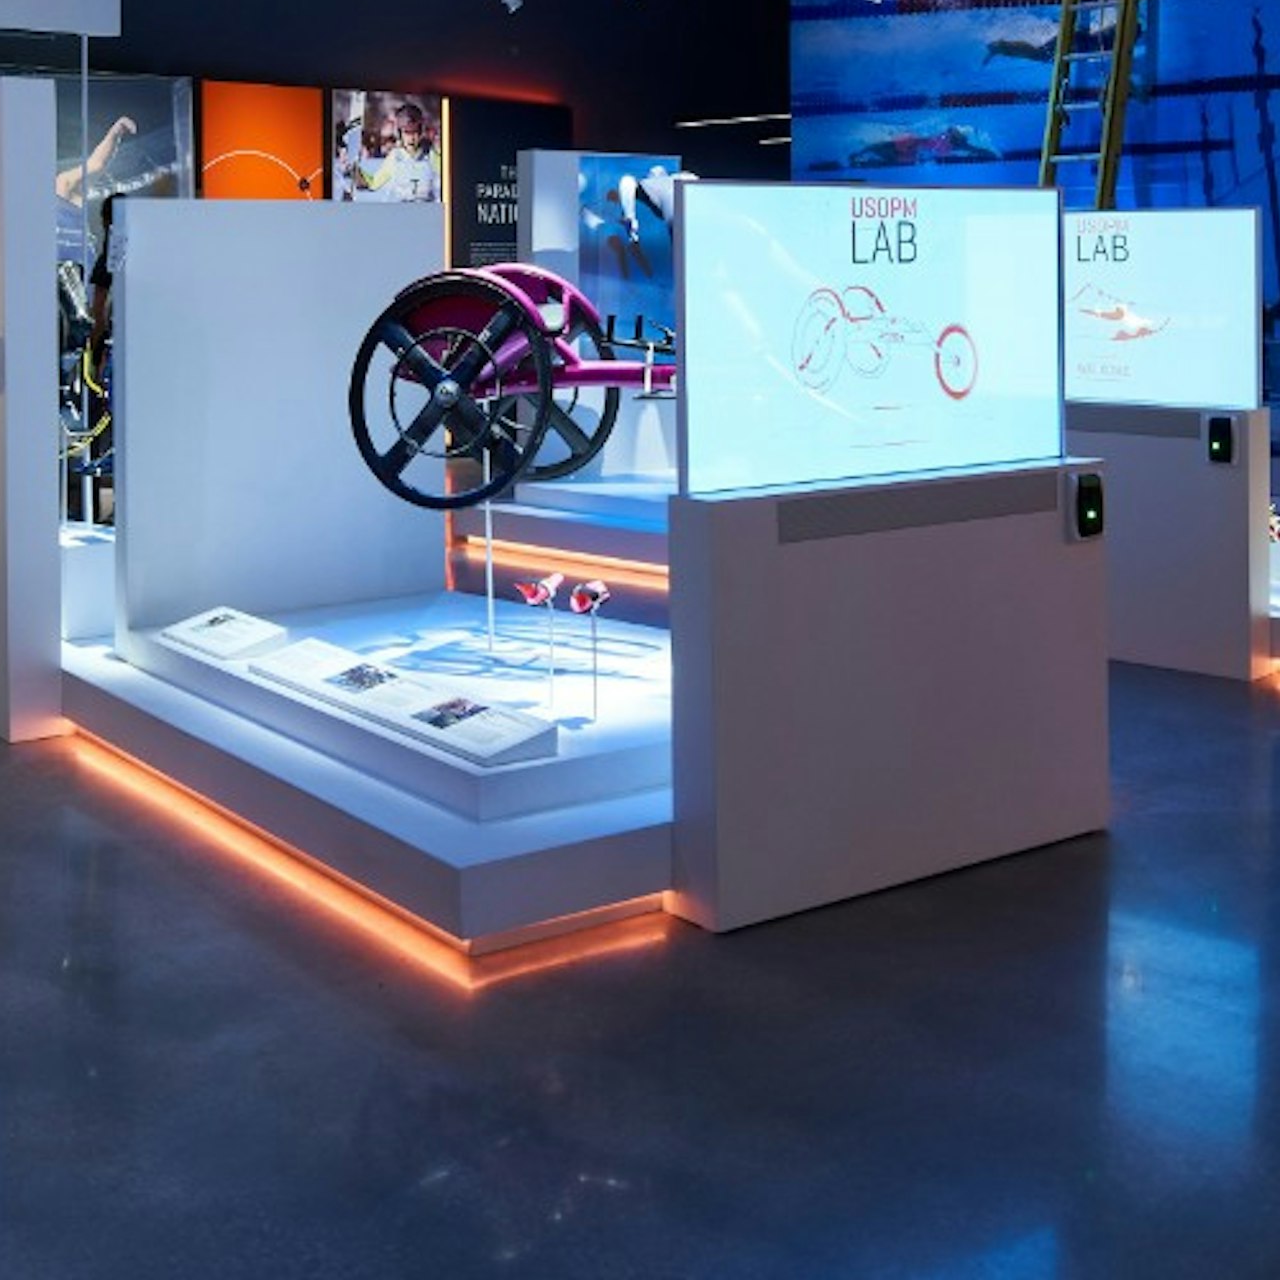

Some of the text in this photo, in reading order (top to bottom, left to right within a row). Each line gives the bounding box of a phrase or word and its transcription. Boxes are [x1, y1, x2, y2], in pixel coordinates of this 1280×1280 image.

[851, 196, 917, 218] USOPM
[851, 220, 917, 264] LAB
[1077, 235, 1129, 262] LAB
